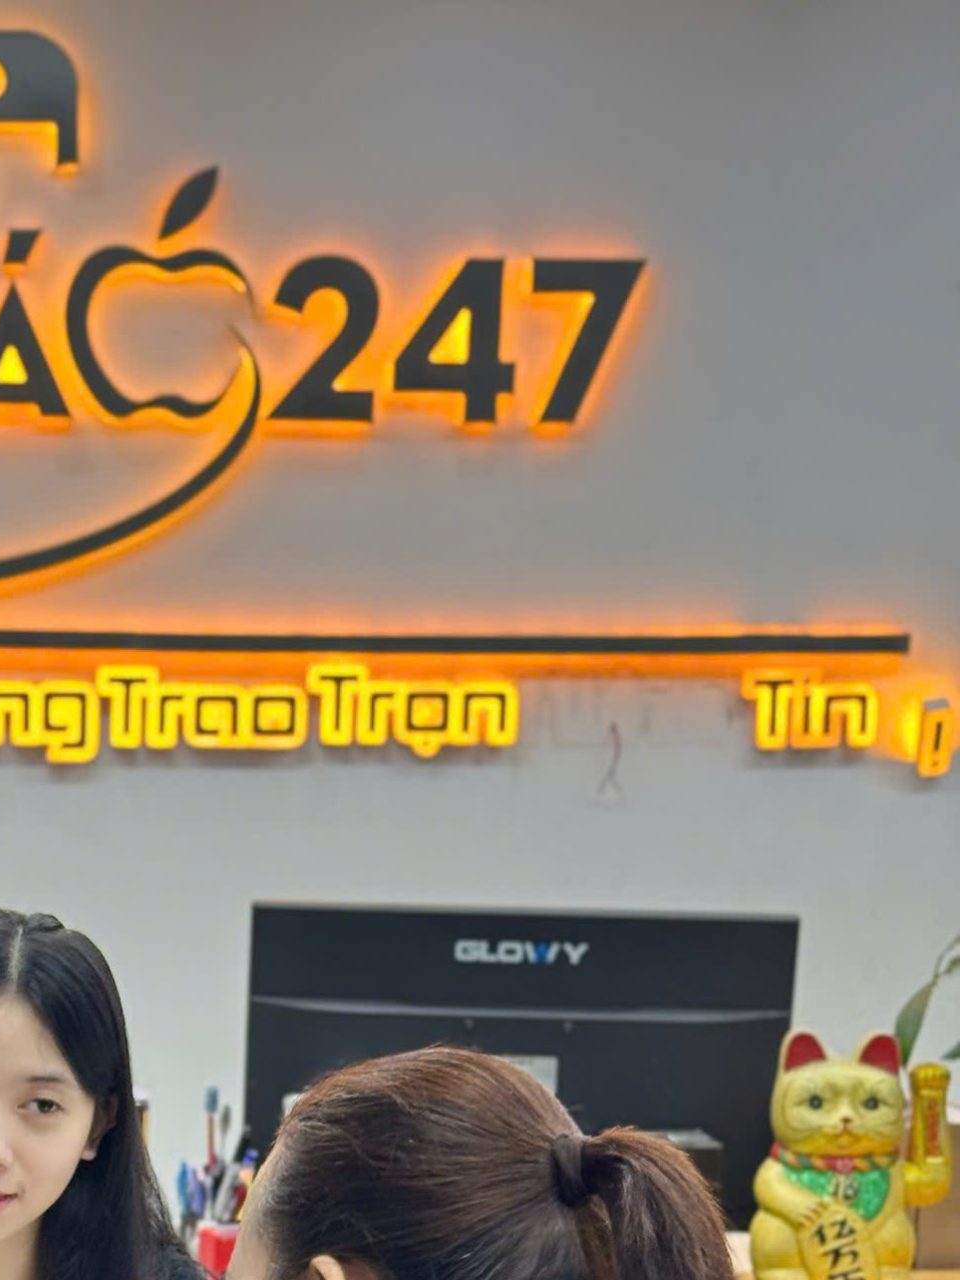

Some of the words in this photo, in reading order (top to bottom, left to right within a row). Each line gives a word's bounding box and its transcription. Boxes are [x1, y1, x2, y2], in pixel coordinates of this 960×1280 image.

[268, 255, 647, 426] 247
[102, 670, 303, 746] Trao
[312, 667, 514, 753] Trọn
[747, 672, 874, 747] Tin
[453, 939, 590, 966] GLOWY
